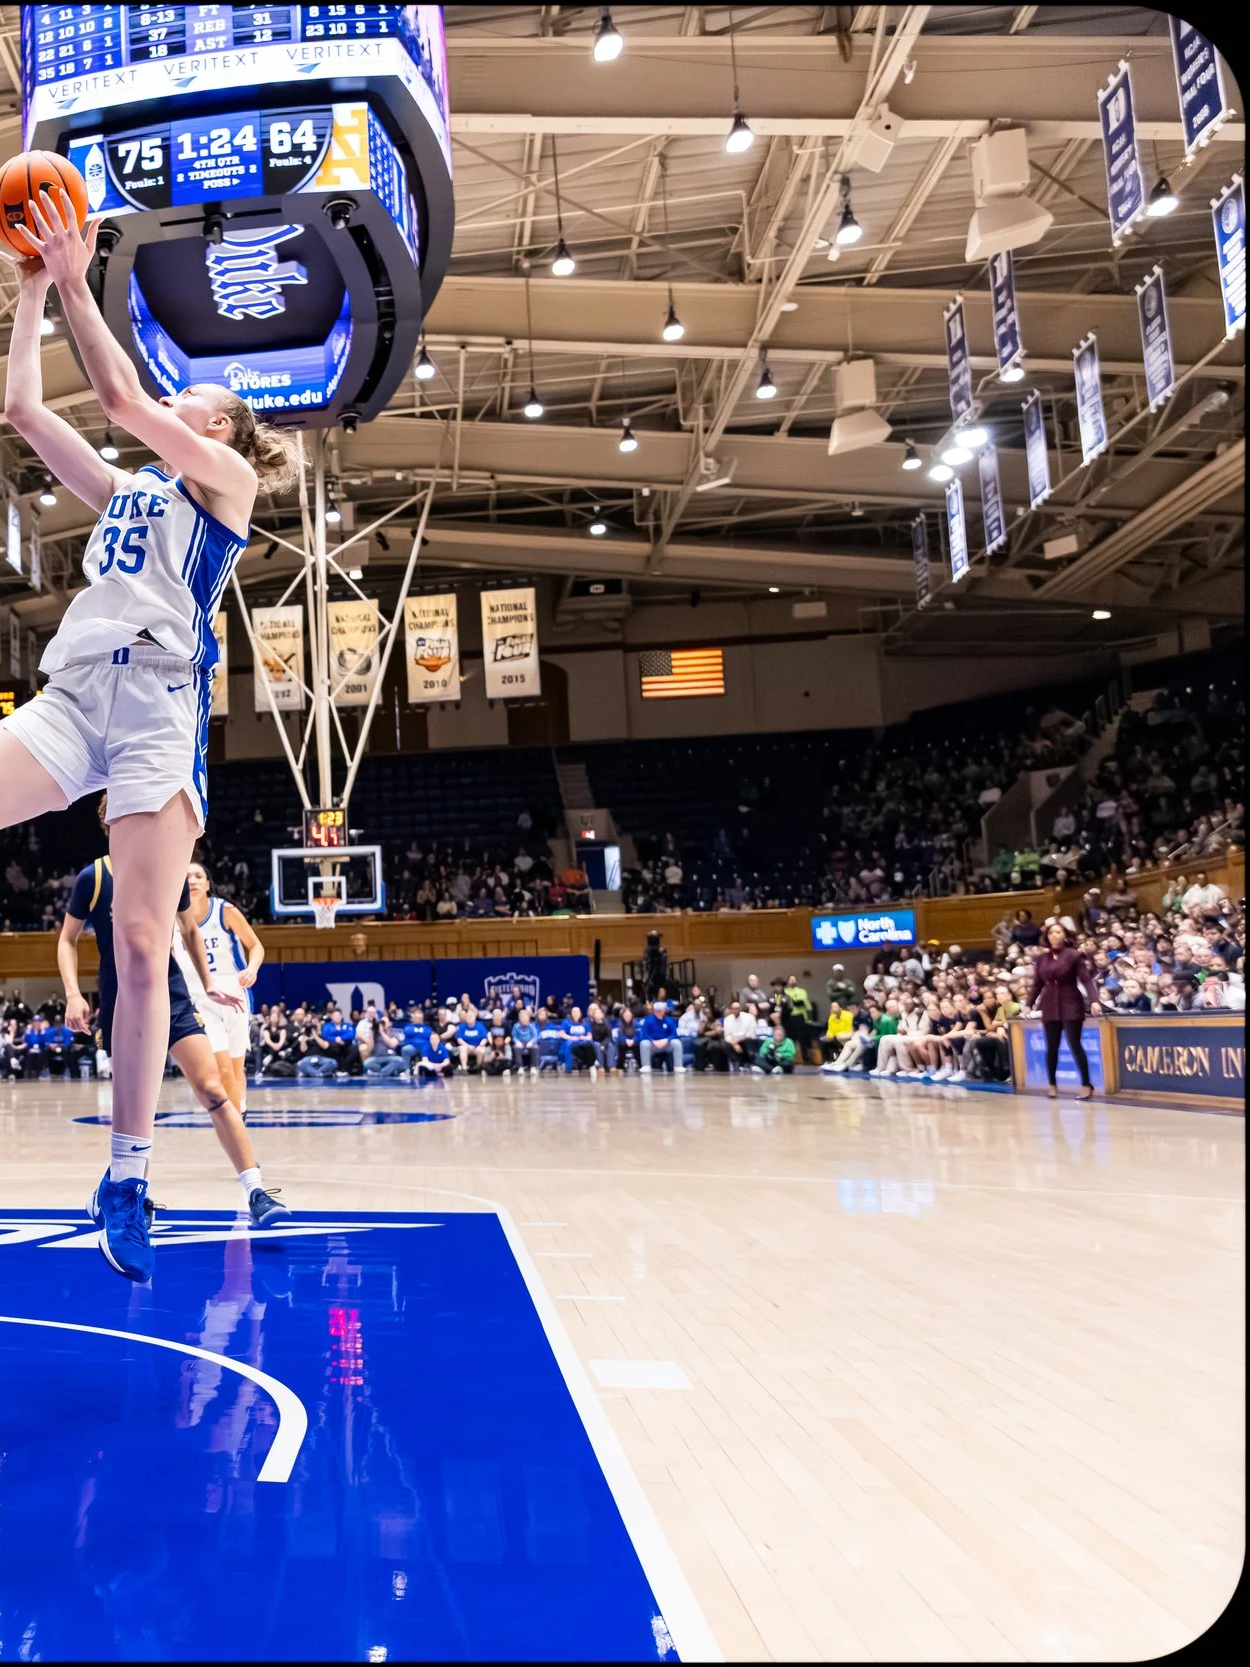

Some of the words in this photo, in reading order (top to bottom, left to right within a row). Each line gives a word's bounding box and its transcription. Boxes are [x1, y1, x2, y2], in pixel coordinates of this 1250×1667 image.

[41, 14, 51, 25] 4
[58, 8, 73, 21] 11
[140, 10, 175, 26] 8-13
[198, 5, 220, 17] FT
[328, 5, 346, 16] 15
[193, 19, 226, 35] REB
[253, 13, 272, 26] 31
[38, 31, 54, 44] 12
[58, 26, 75, 39] 10
[79, 21, 95, 34] 10
[103, 17, 113, 28] 2
[148, 27, 168, 41] 37
[253, 29, 273, 43] 12
[305, 24, 325, 37] 23
[329, 22, 347, 35] 10
[355, 22, 366, 33] 3
[379, 21, 389, 33] 1
[38, 49, 55, 62] 22
[58, 44, 75, 57] 21
[104, 36, 113, 47] 1
[149, 44, 168, 58] 18
[193, 36, 227, 52] AST
[286, 43, 383, 60] VERITEXT
[38, 67, 55, 80] 35
[59, 62, 75, 76] 18
[83, 57, 92, 70] 7
[104, 54, 113, 66] 1
[164, 52, 259, 75] VERITEXT
[48, 70, 138, 99] VERITEXT
[177, 125, 257, 160] 1:24
[269, 119, 318, 154] 64
[118, 137, 163, 175] 75
[193, 158, 215, 169] 4TH
[218, 156, 240, 167] QTR
[269, 157, 302, 168] Fouls:
[304, 155, 312, 165] 4
[188, 165, 245, 181] TIMEOUTS
[125, 178, 156, 190] Fouls:
[157, 176, 165, 186] 1
[203, 178, 231, 189] POSS
[230, 374, 292, 392] STORES
[97, 490, 169, 526] UKE
[99, 525, 148, 576] 35
[490, 602, 527, 613] NATIONAL
[261, 630, 301, 640] HAMPIONS
[111, 647, 130, 665] D
[423, 680, 447, 689] 2010
[502, 674, 526, 684] 2015
[345, 684, 367, 693] 2001
[318, 811, 344, 826] 1:23
[857, 916, 895, 932] North
[858, 929, 913, 944] Carolina
[1124, 1045, 1211, 1077] CAMERON
[1221, 1047, 1246, 1079] IN
